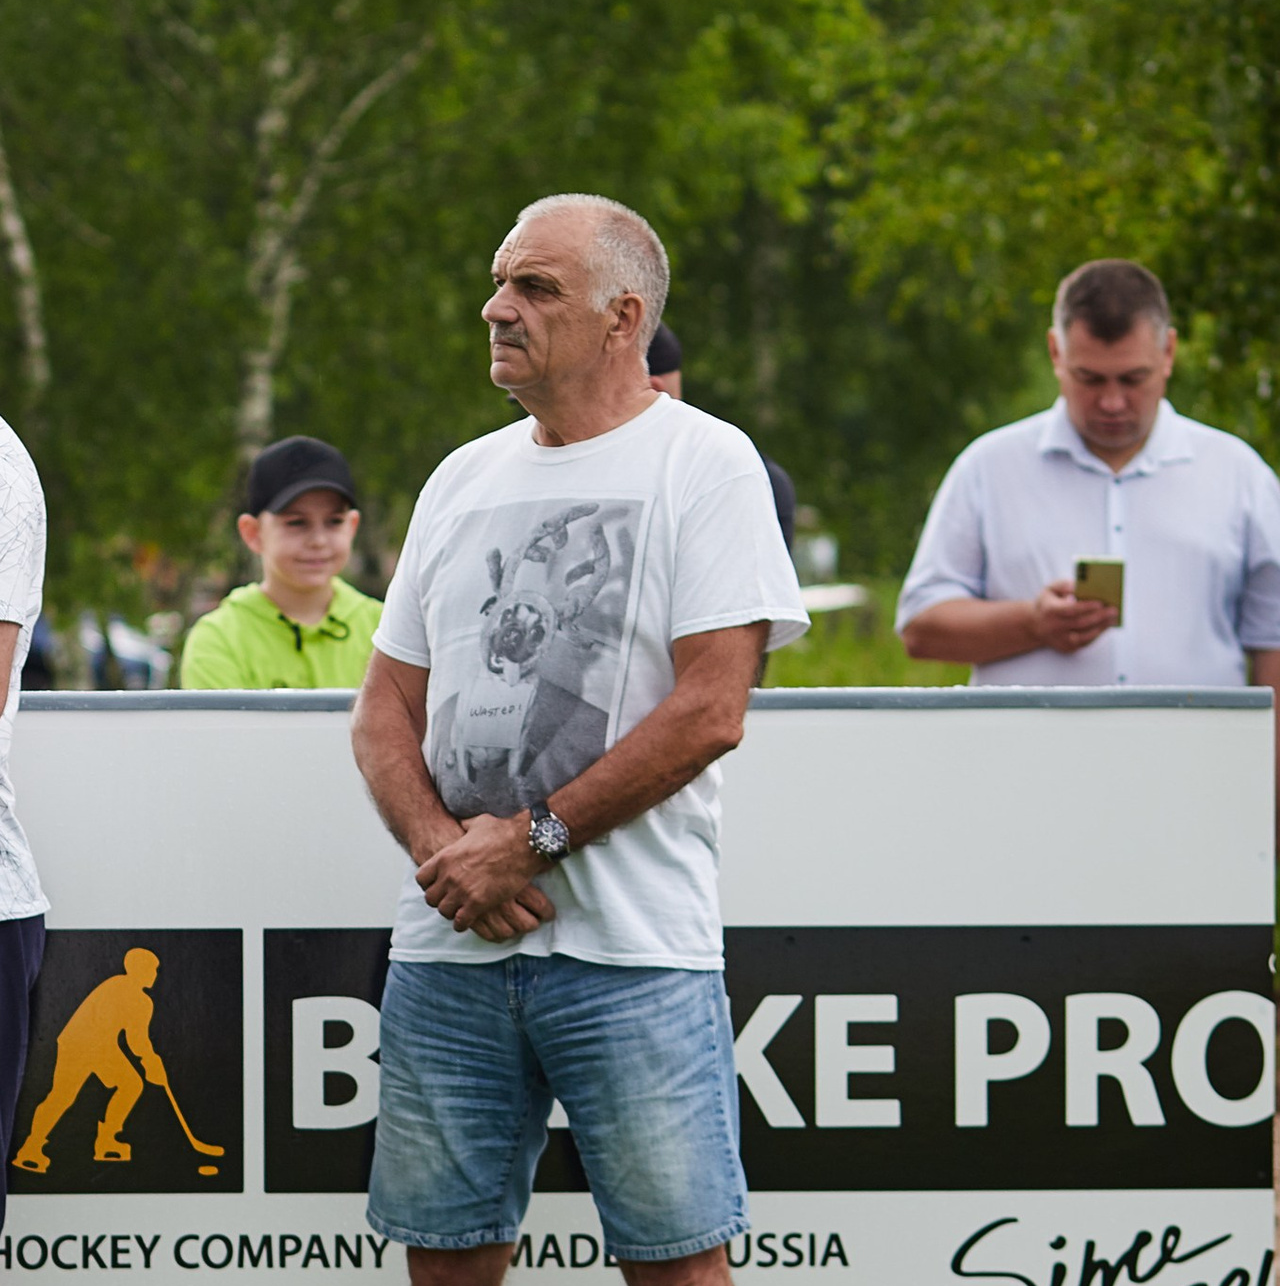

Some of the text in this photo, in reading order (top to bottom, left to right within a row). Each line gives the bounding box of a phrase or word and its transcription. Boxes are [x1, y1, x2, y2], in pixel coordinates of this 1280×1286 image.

[292, 996, 381, 1130] B
[955, 990, 1276, 1128] PRO
[173, 1234, 390, 1270] COMPANY
[727, 1232, 850, 1268] USSIA
